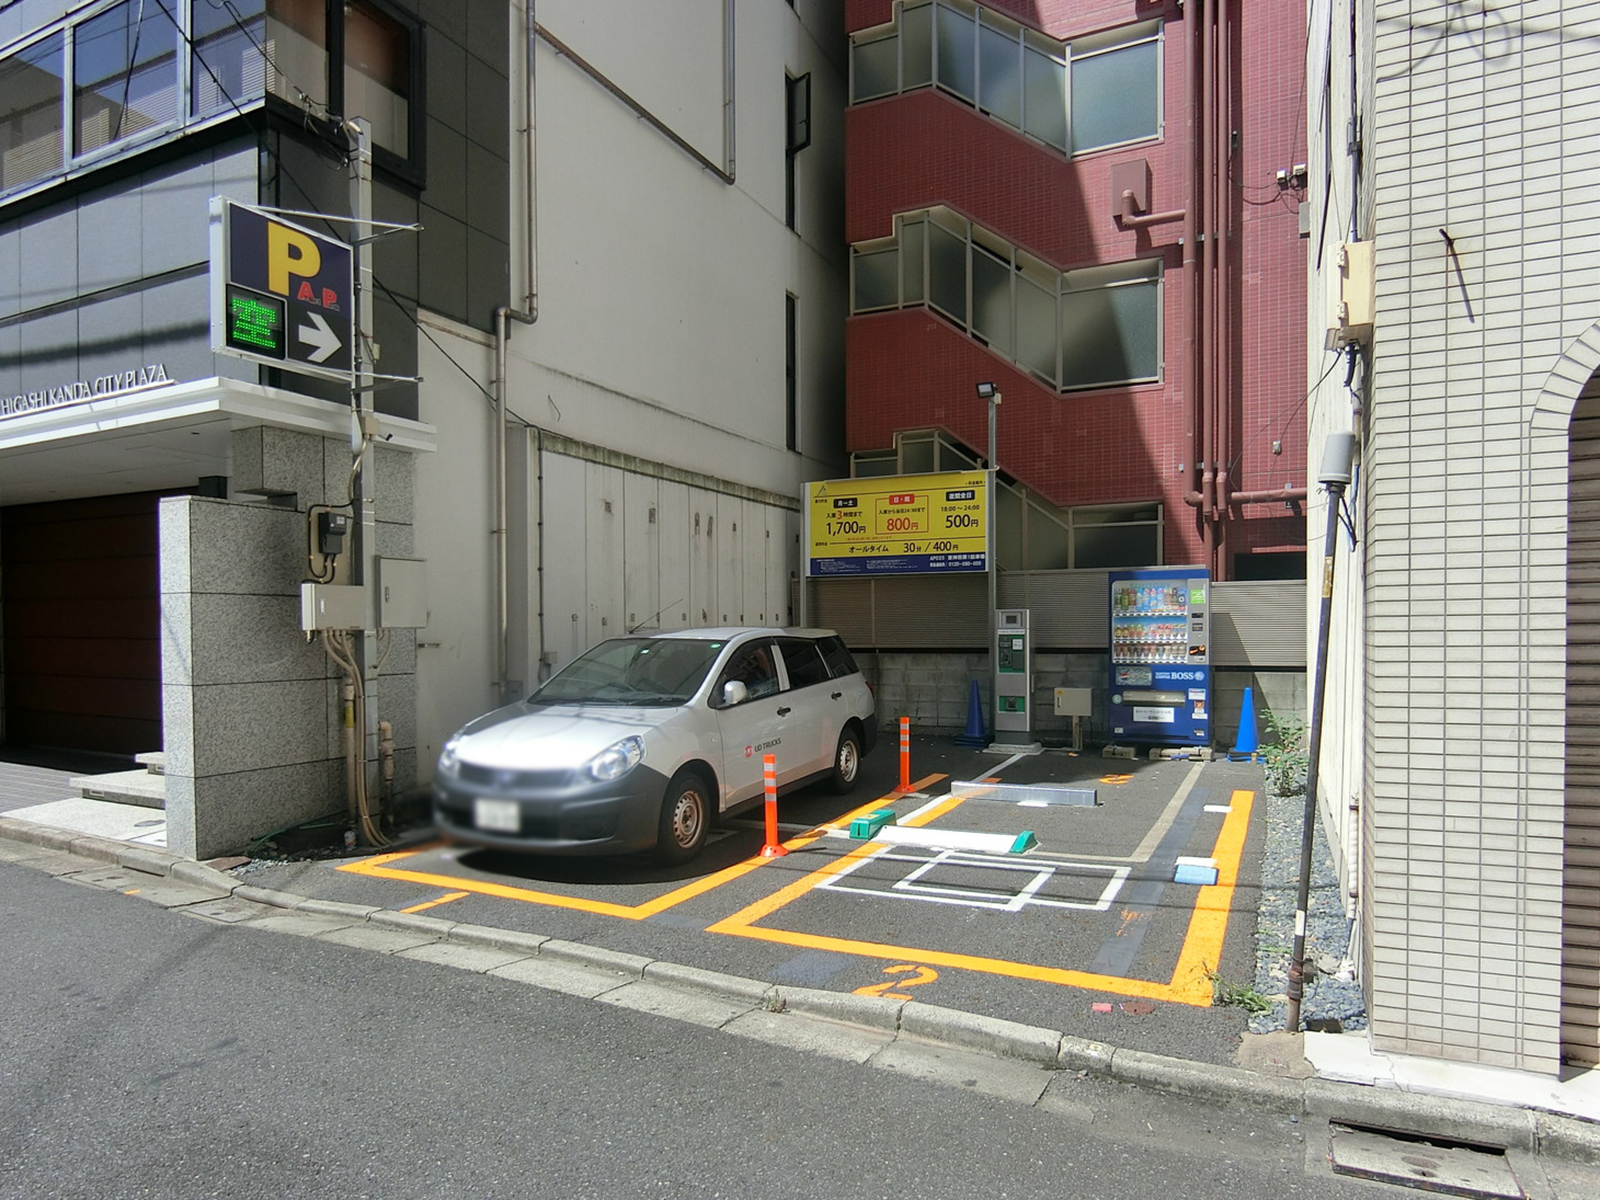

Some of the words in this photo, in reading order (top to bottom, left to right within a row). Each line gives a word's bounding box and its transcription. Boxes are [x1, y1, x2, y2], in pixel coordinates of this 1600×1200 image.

[268, 221, 321, 296] P
[232, 298, 276, 349] 空
[1, 390, 48, 415] HIGASHI
[50, 381, 93, 405] KANDA
[95, 373, 123, 395] CITY
[125, 363, 168, 389] PLAZA
[826, 521, 866, 537] 1,700円
[887, 517, 919, 531] 800円
[945, 514, 979, 529] 500円
[848, 545, 889, 553] オールタイム
[1171, 671, 1194, 680] BOSS
[762, 737, 782, 750] TRUCKS
[852, 964, 939, 1001] 2
